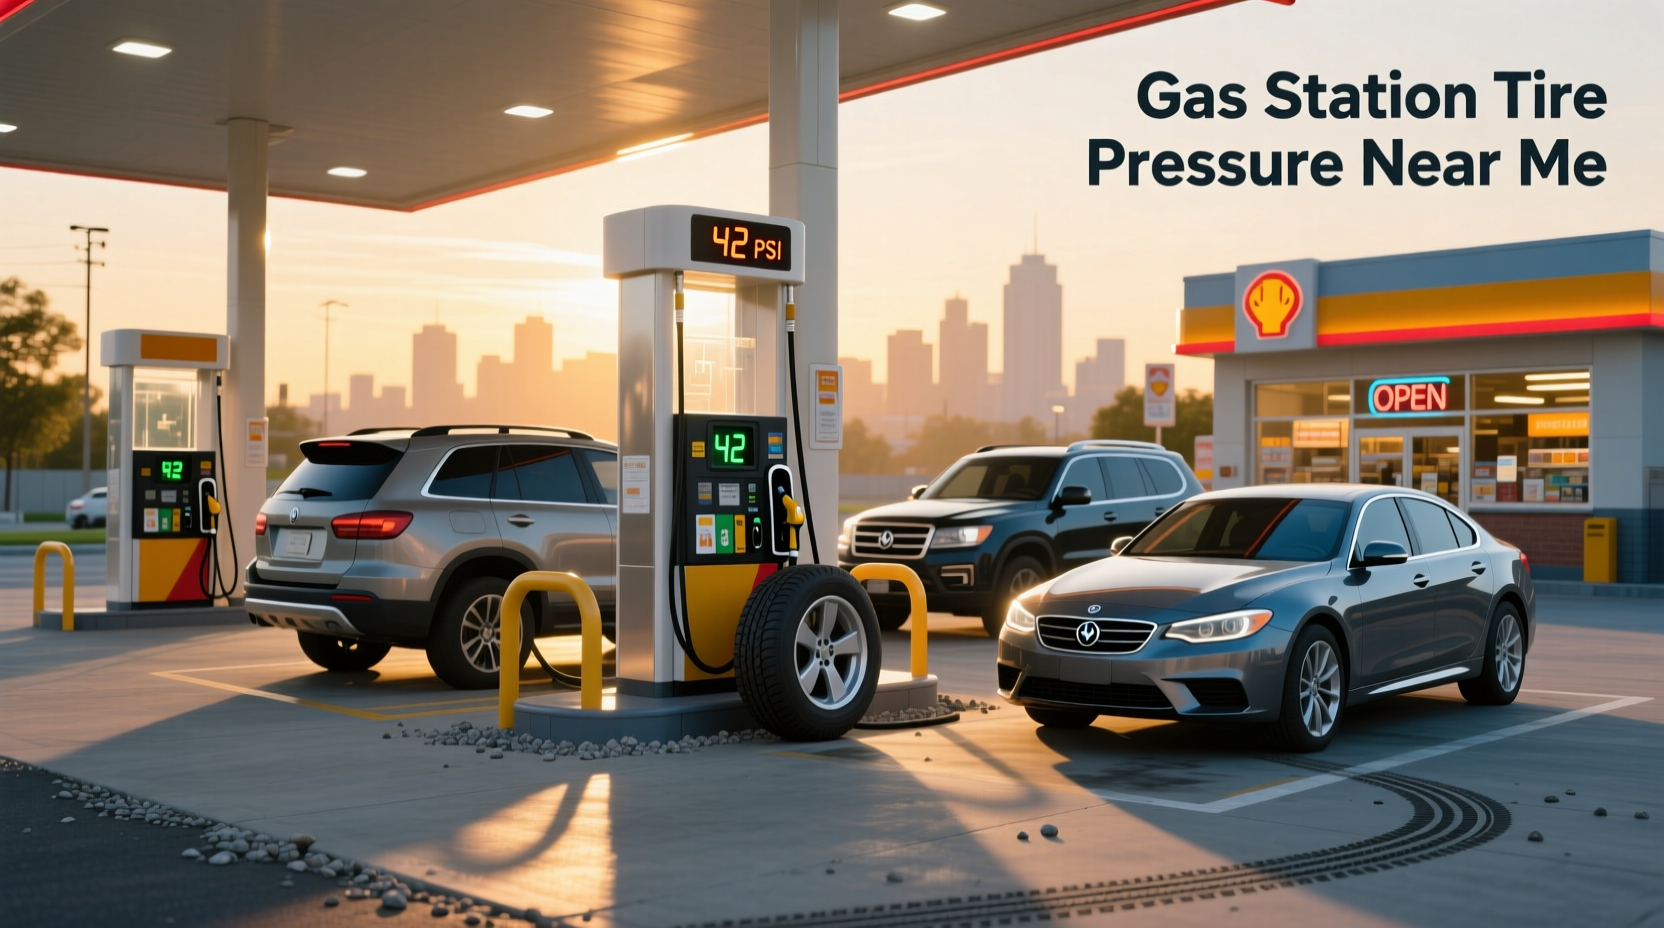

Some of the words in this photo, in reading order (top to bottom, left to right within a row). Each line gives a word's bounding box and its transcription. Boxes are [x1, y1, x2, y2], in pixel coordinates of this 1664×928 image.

[712, 225, 749, 259] 42
[754, 239, 782, 261] PSI
[1373, 382, 1447, 412] OPEN
[714, 433, 746, 464] 42
